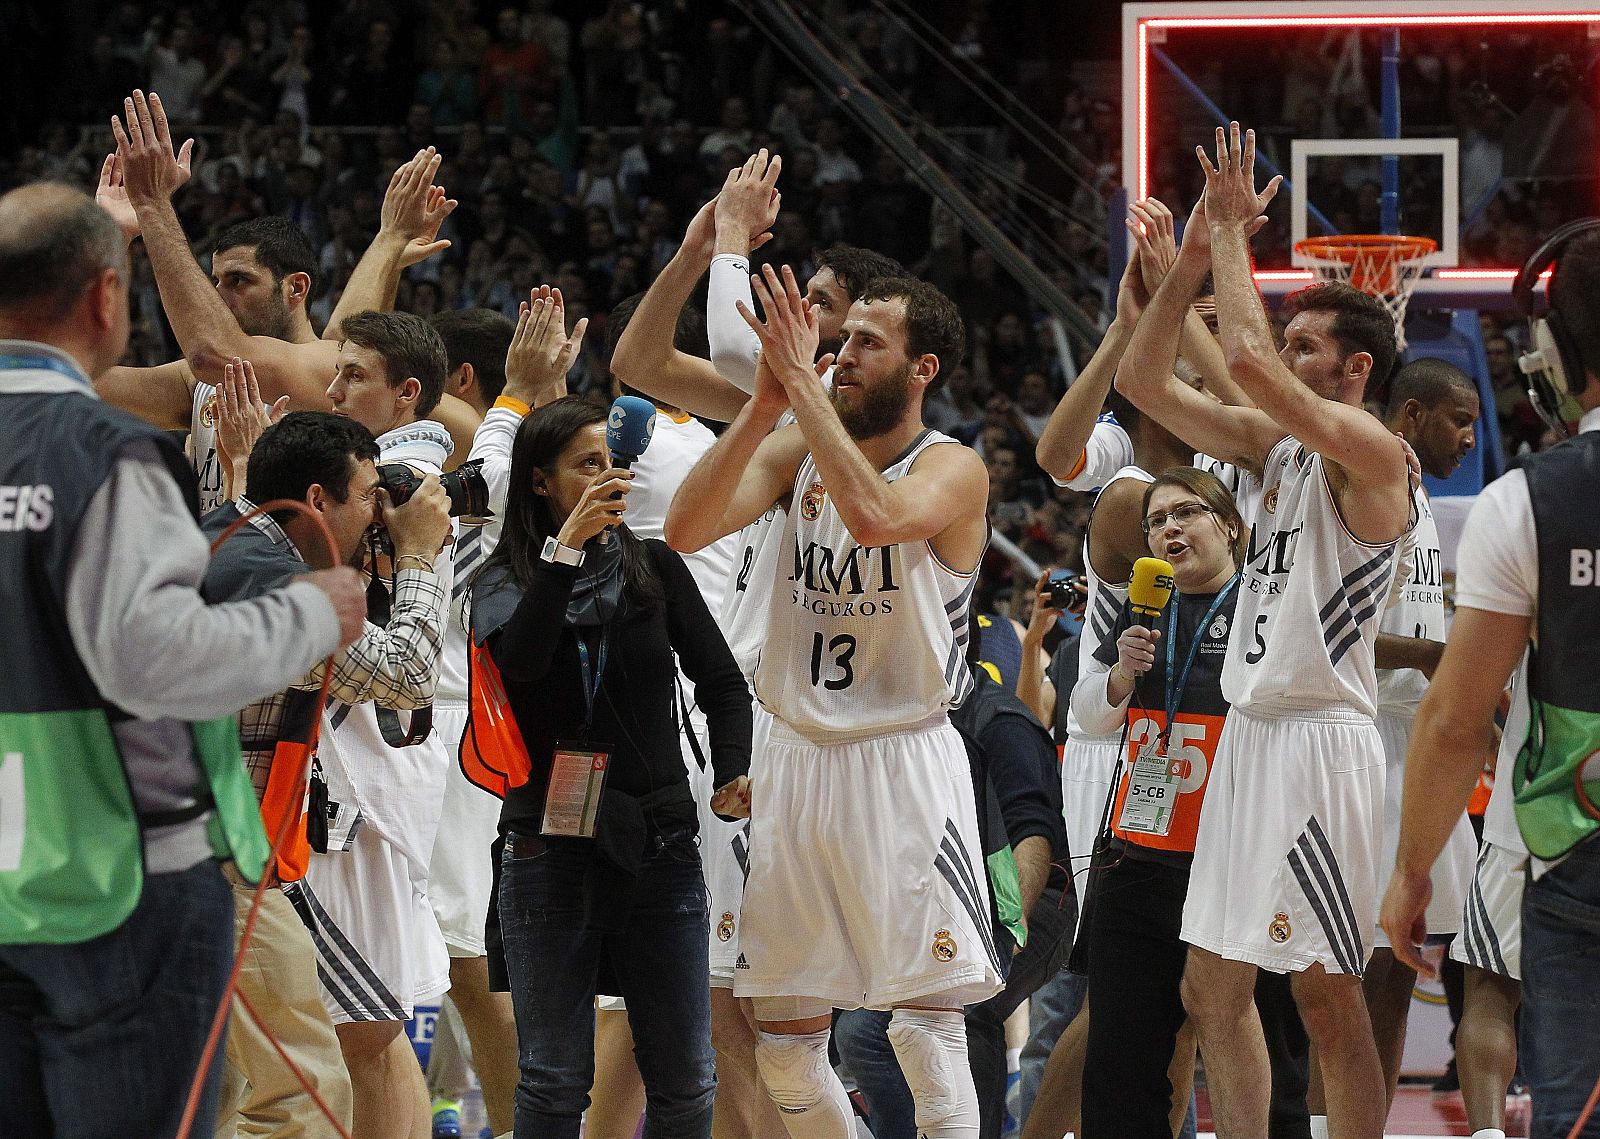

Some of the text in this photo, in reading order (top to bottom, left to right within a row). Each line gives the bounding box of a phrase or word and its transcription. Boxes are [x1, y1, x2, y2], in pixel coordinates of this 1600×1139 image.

[788, 532, 899, 595] MMT
[1406, 546, 1442, 587] MT
[792, 590, 892, 617] SEGUROS
[811, 632, 857, 691] 13
[1245, 614, 1268, 664] 5
[1131, 784, 1166, 799] 5-CB
